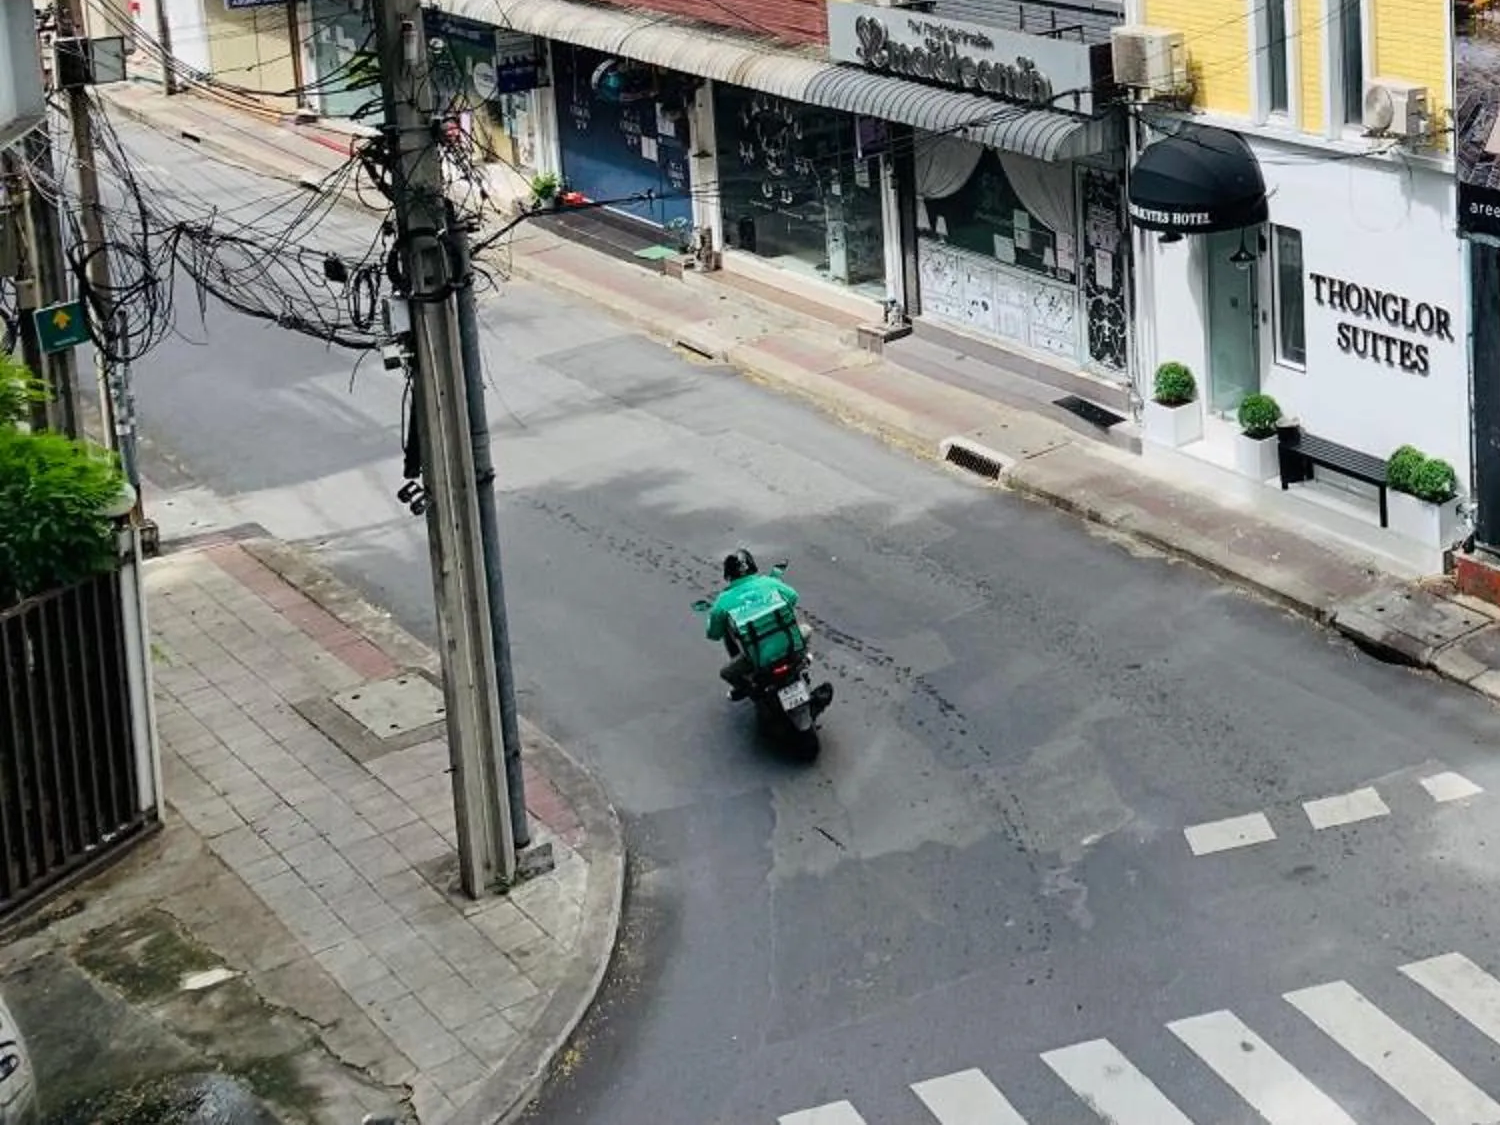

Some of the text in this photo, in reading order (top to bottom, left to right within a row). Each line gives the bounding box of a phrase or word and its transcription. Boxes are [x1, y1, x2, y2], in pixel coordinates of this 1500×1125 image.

[1172, 212, 1213, 226] HOTEL
[1309, 272, 1455, 344] THONGLOR
[1336, 321, 1430, 378] SUITES
